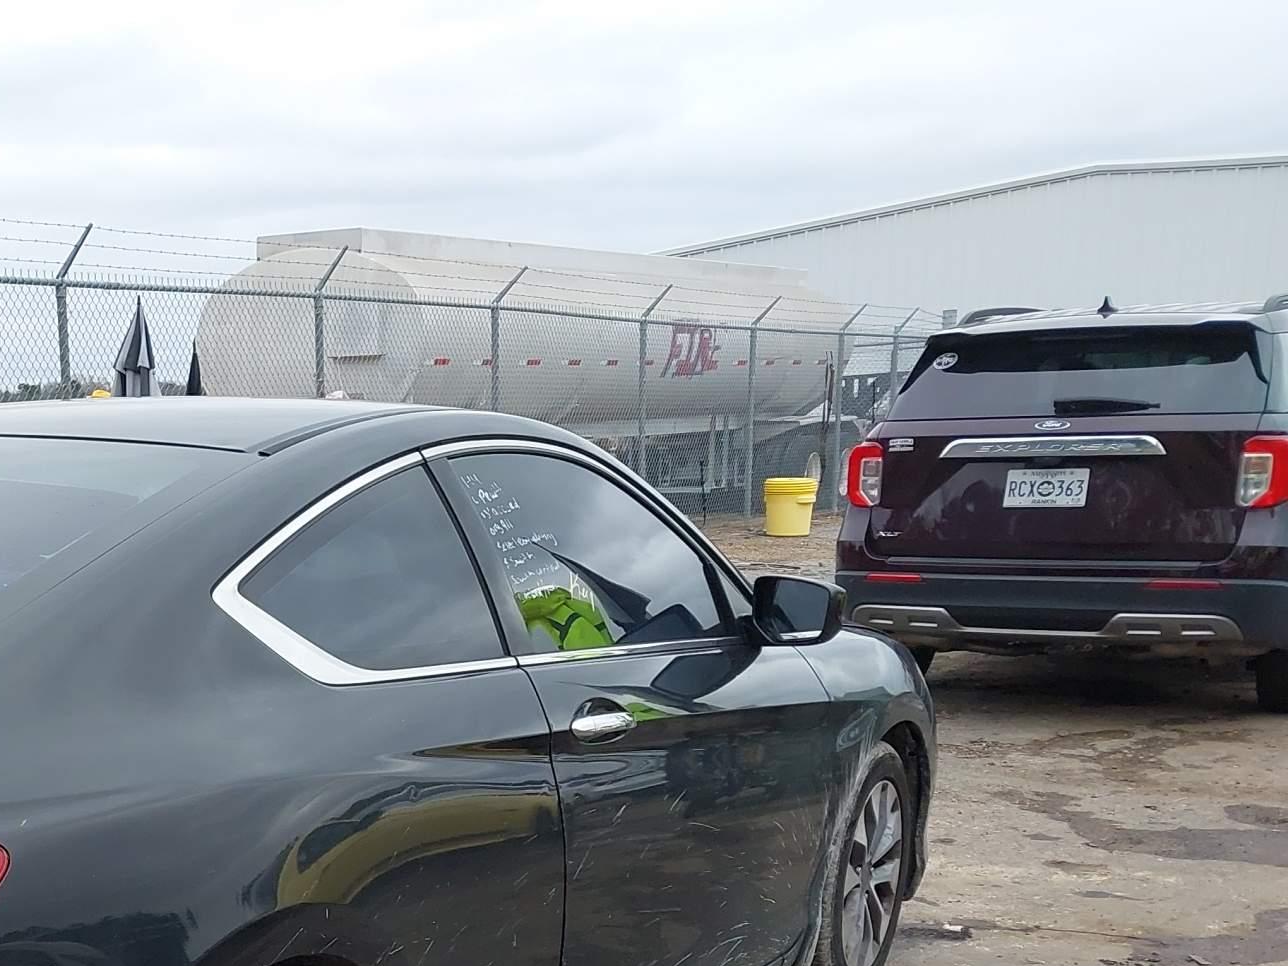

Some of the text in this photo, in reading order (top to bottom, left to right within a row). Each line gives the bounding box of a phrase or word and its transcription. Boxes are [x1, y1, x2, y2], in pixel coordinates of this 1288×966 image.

[975, 442, 1122, 454] EXPLORER
[1008, 479, 1085, 498] RCX 363
